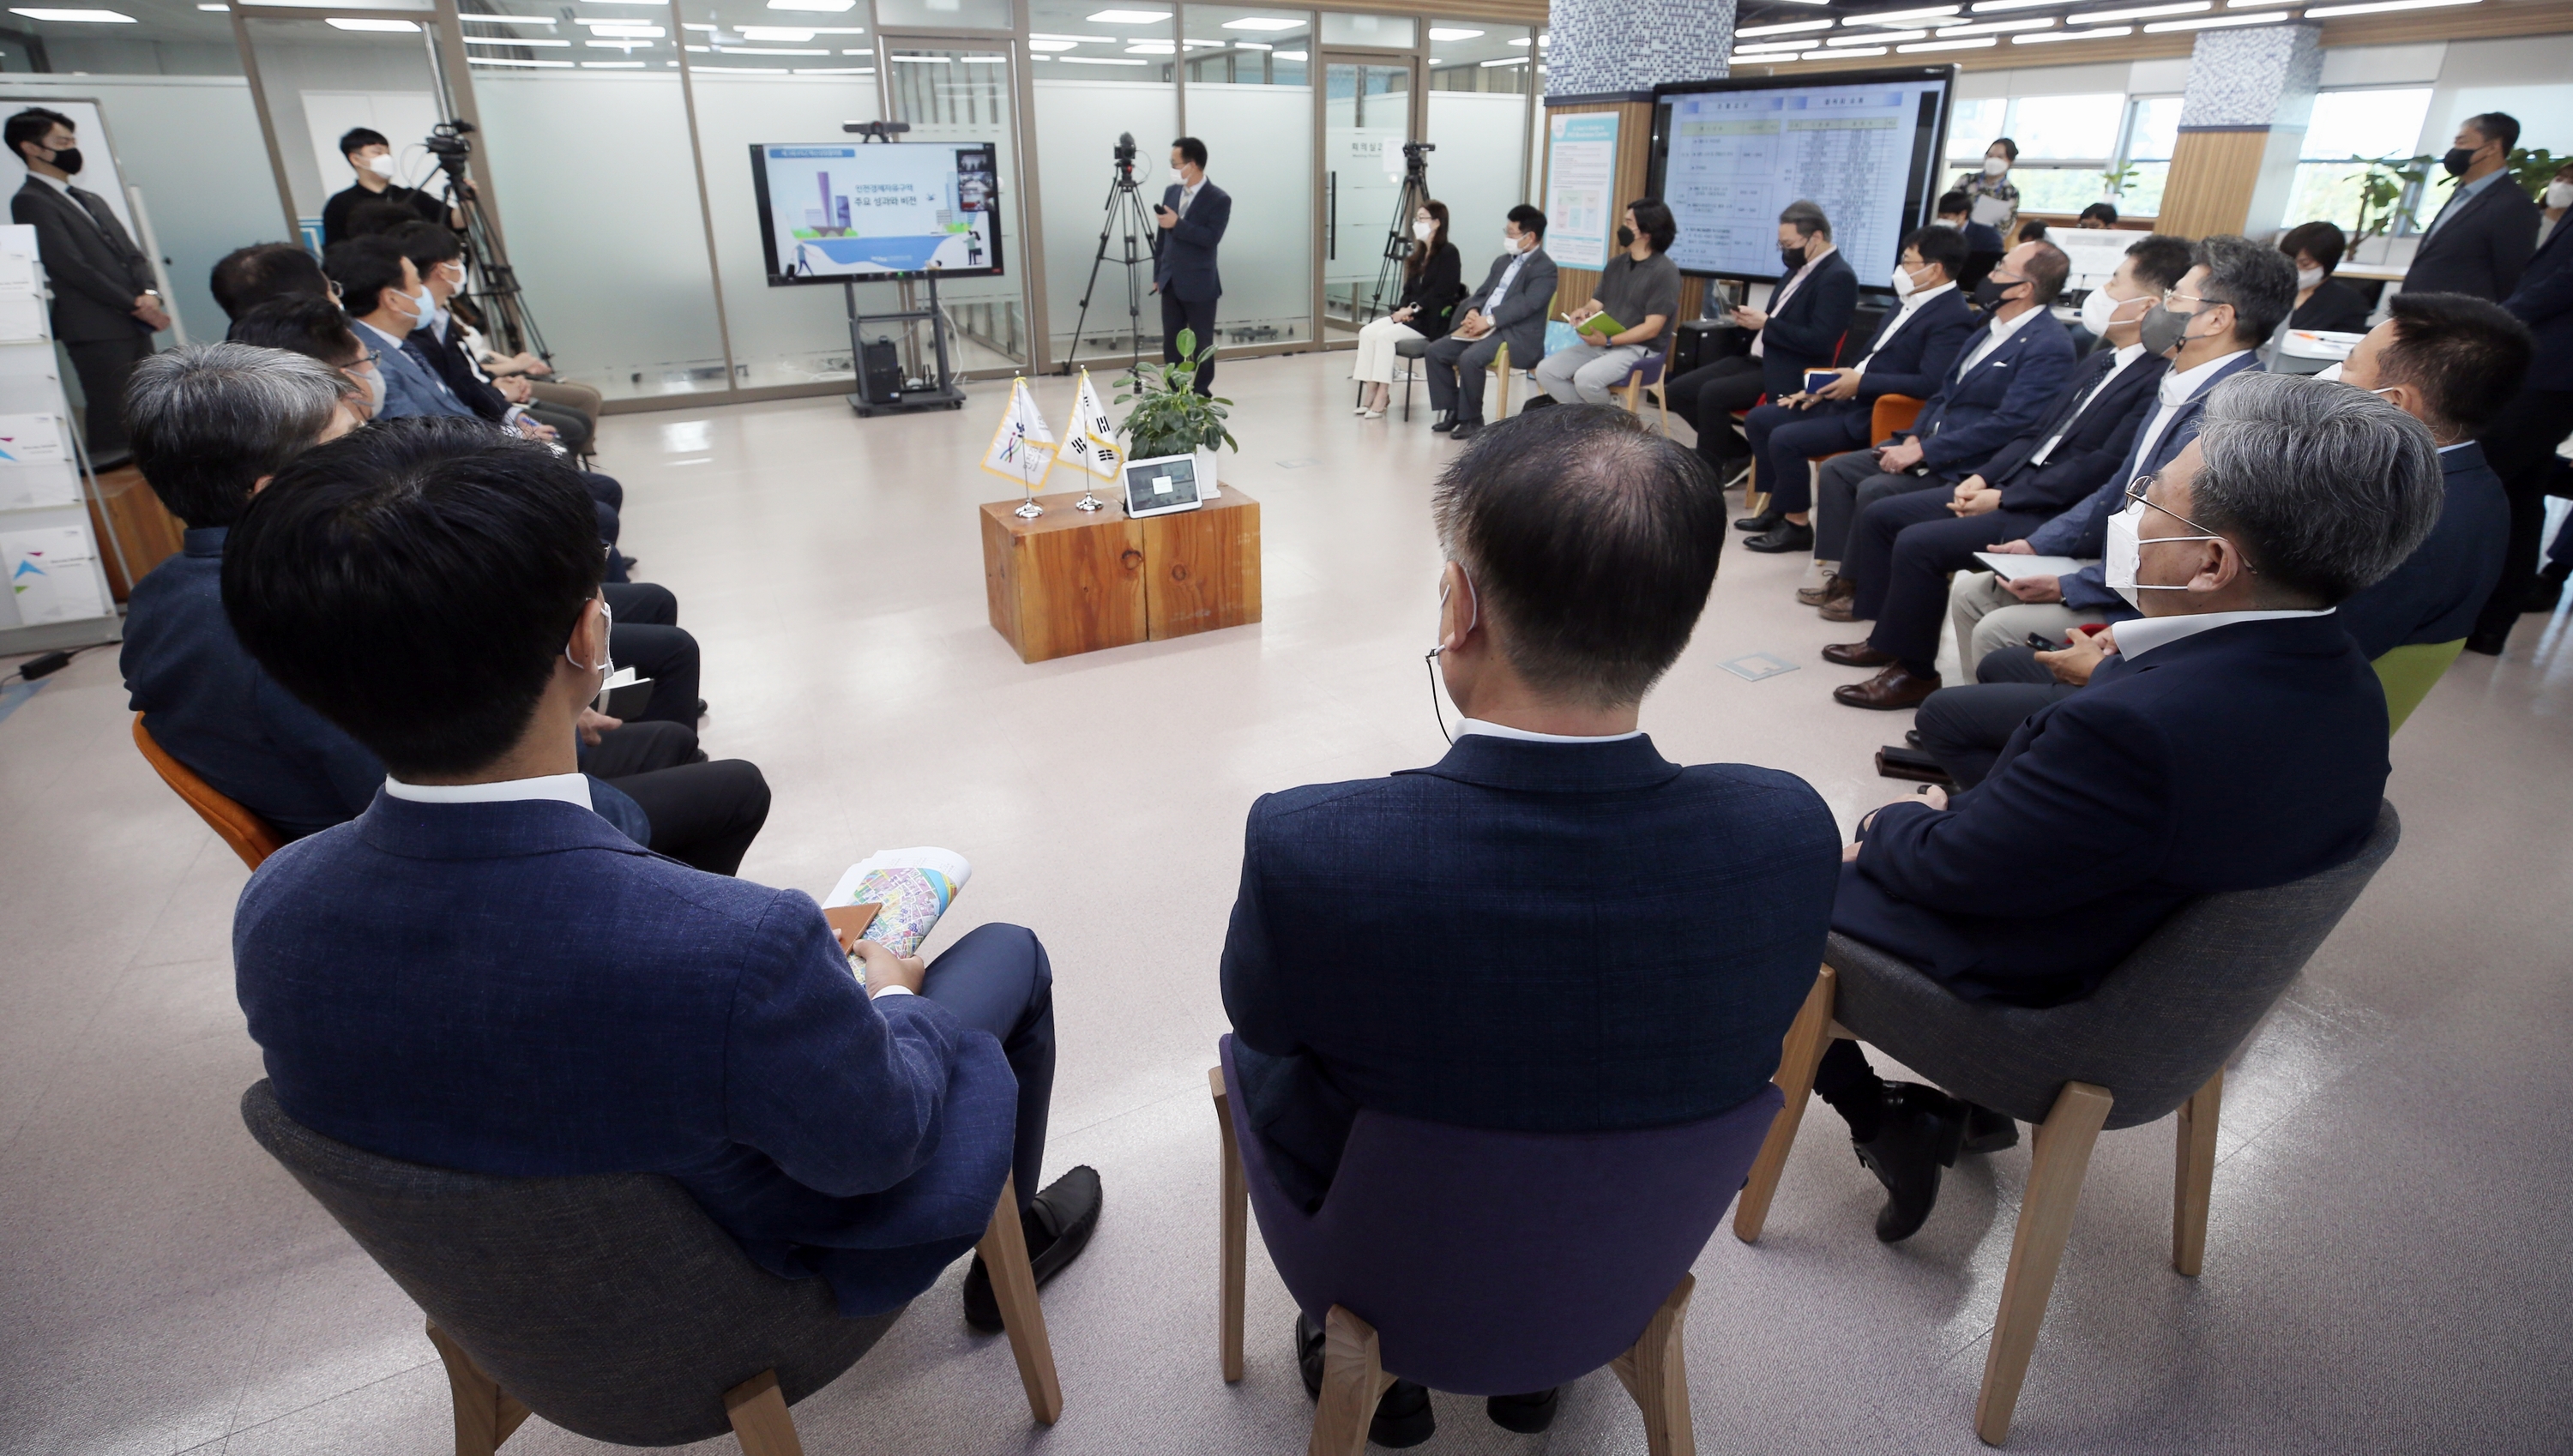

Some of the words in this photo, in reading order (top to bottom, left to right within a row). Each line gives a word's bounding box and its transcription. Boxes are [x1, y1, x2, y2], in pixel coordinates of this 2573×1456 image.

[855, 183, 913, 194] 인천경제자유구역
[854, 196, 871, 207] 주요
[874, 196, 899, 207] 성과와
[901, 196, 917, 206] 비전
